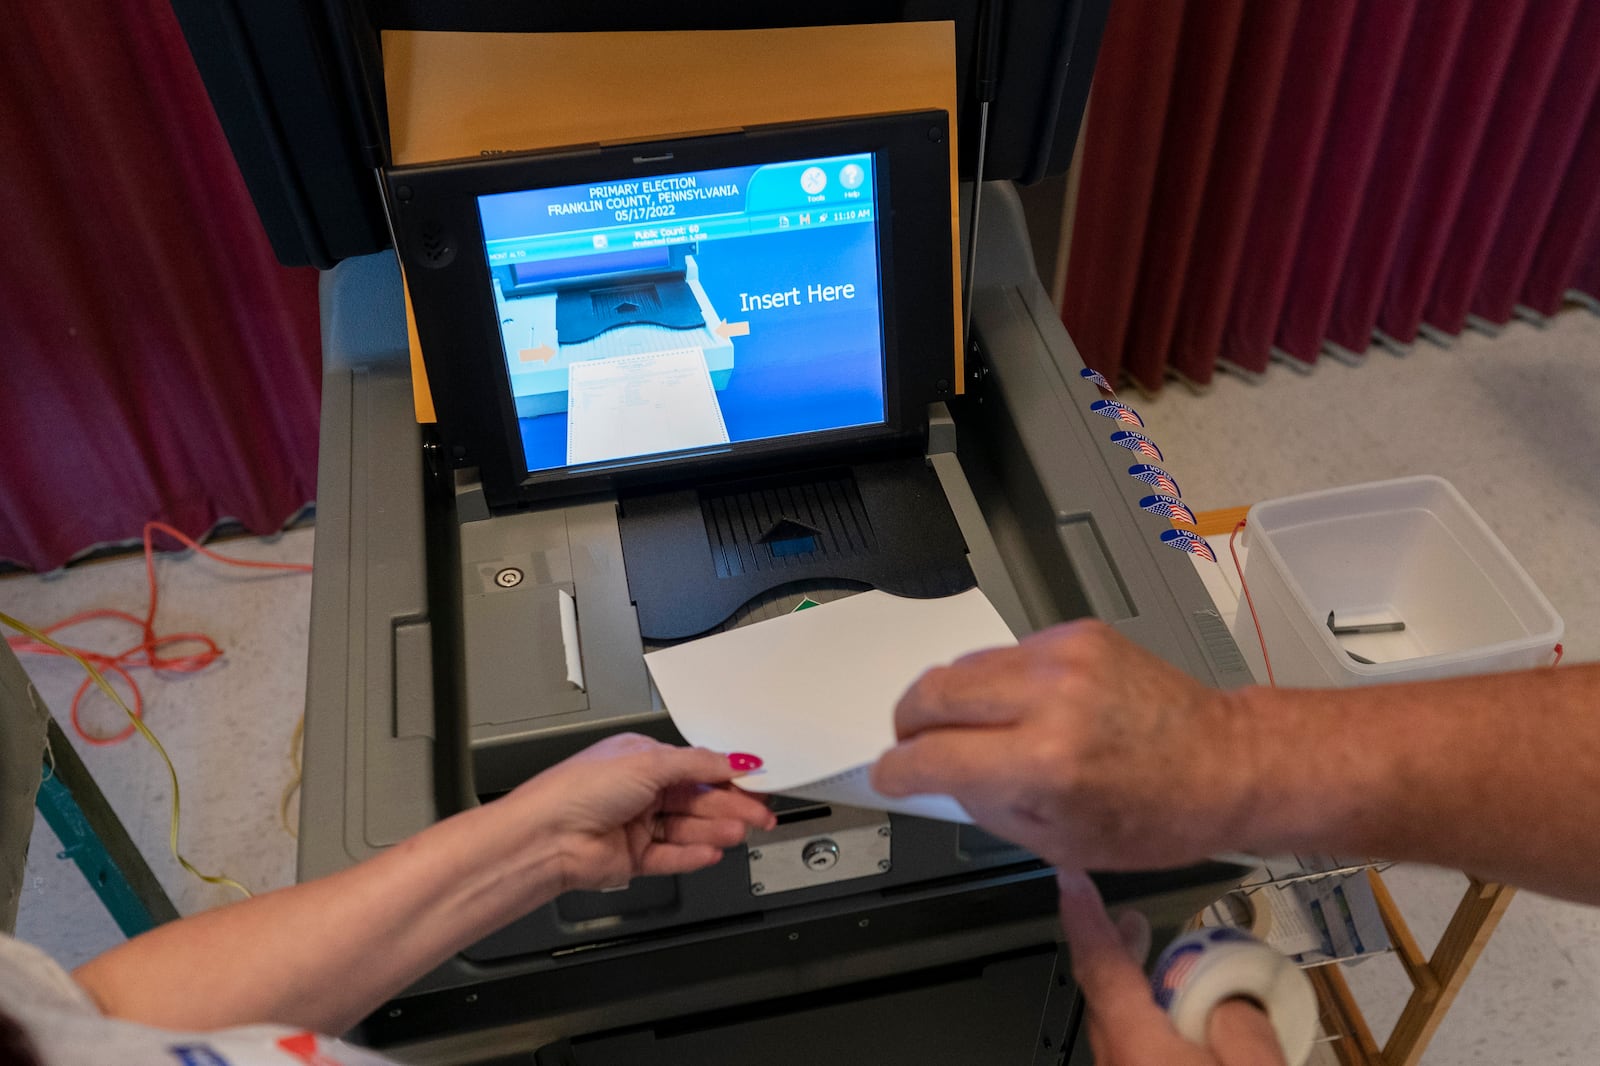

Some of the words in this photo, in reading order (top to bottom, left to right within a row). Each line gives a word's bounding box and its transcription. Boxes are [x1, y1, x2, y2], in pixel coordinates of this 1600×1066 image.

[589, 183, 639, 199] PRIMARY
[642, 176, 697, 193] ELECTION
[844, 190, 860, 199] Help
[547, 200, 603, 216] FRANKLIN
[606, 194, 656, 209] COUNTY,
[658, 184, 739, 204] PENNSYLVANIA
[807, 194, 826, 203] Tools
[615, 205, 676, 222] 05/17/2022
[834, 211, 856, 221] 11:10
[858, 209, 871, 218] AM
[634, 230, 658, 240] Public
[660, 226, 686, 237] Count:
[740, 287, 801, 312] Insert
[807, 283, 855, 303] Here
[1149, 465, 1172, 481] VOTED
[1160, 495, 1185, 508] VOTED
[1181, 530, 1206, 545] VOTED
